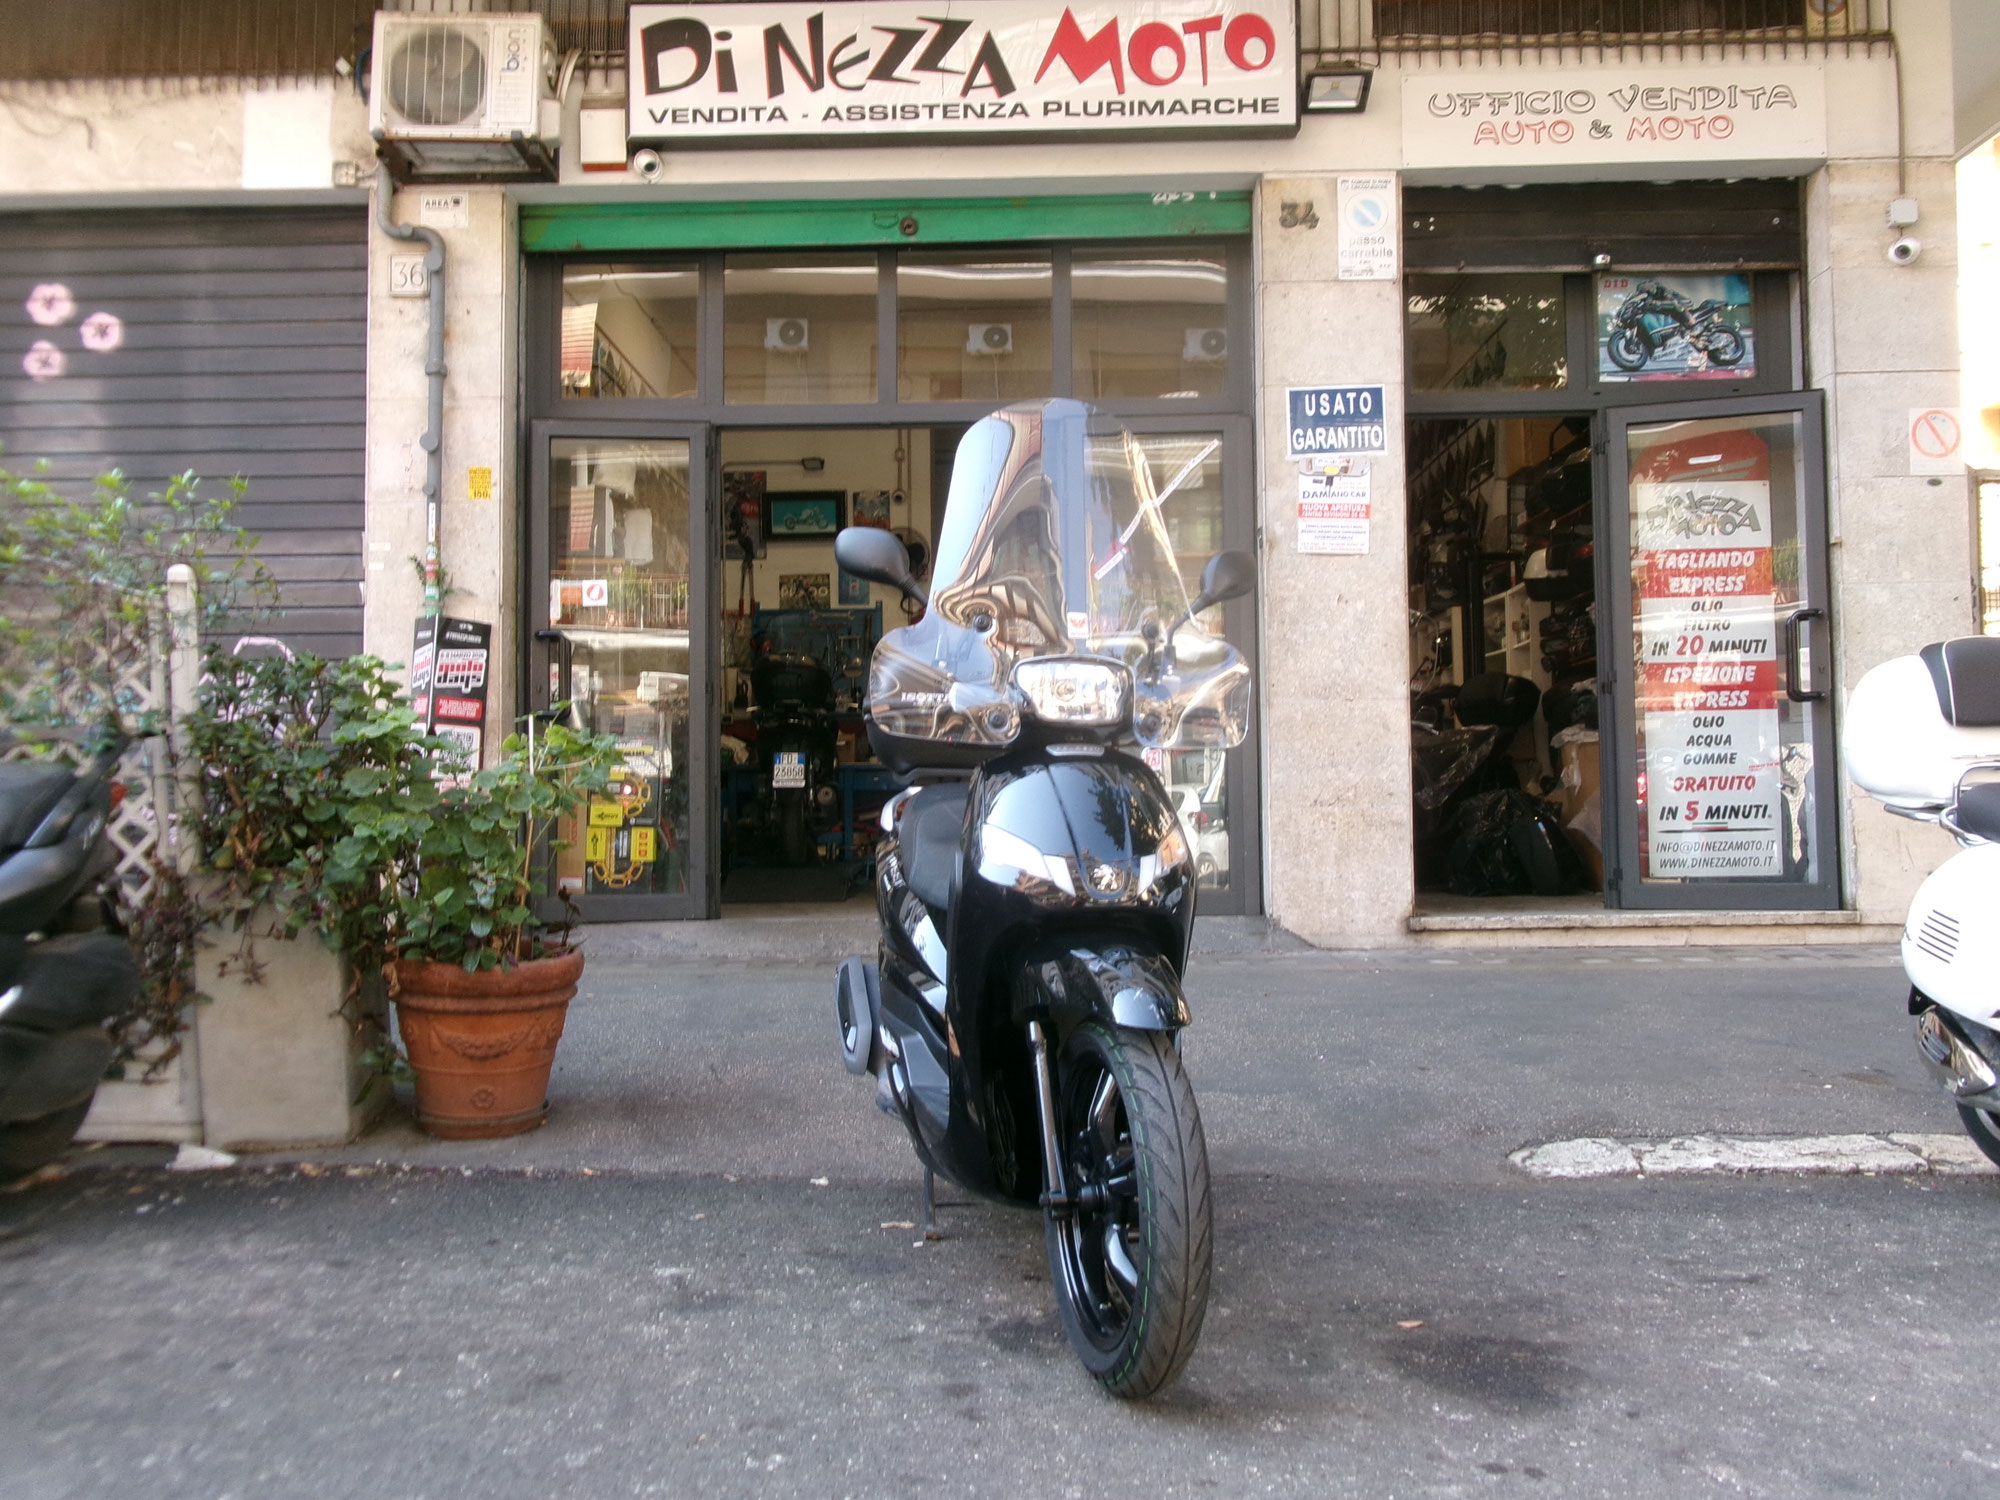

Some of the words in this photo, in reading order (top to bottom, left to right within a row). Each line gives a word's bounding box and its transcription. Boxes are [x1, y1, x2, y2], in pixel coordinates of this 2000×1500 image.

[641, 17, 738, 96] Di
[1033, 5, 1275, 95] MOTO
[1428, 89, 1596, 117] UFFICIO
[1609, 84, 1798, 113] VENDITA
[648, 105, 789, 124] VENDITA
[822, 102, 1030, 121] ASSISTENZA
[1043, 97, 1280, 117] PLURIMARCHE
[1474, 119, 1575, 145] AUTO
[1589, 119, 1612, 139] &
[1627, 115, 1735, 141] MOTO
[1349, 236, 1385, 248] passo
[393, 261, 424, 288] 36
[1304, 391, 1372, 417] USATO
[1292, 425, 1383, 450] GARANTITO
[1656, 551, 1755, 570] TAGLIANDO
[1669, 575, 1746, 593] EXPRESS
[1690, 600, 1723, 612] OLIO
[1684, 619, 1731, 632] FILTRO
[1652, 641, 1670, 656] IN
[1676, 635, 1705, 656] 20
[1709, 638, 1768, 655] MINUTI
[1663, 665, 1757, 684] ISPEZIONE
[1673, 690, 1750, 709] EXPRESS
[1693, 716, 1725, 729] OLIO
[1686, 734, 1732, 748] ACQUA
[1683, 752, 1738, 765] GOMME
[1673, 775, 1757, 793] GRATUITO
[1659, 806, 1679, 821] IN
[1684, 800, 1700, 821] 5
[1656, 839, 1776, 853] INFO@DINEZZAMOTO.IT
[1659, 856, 1773, 869] WWW.DINEZZAMOTO.IT
